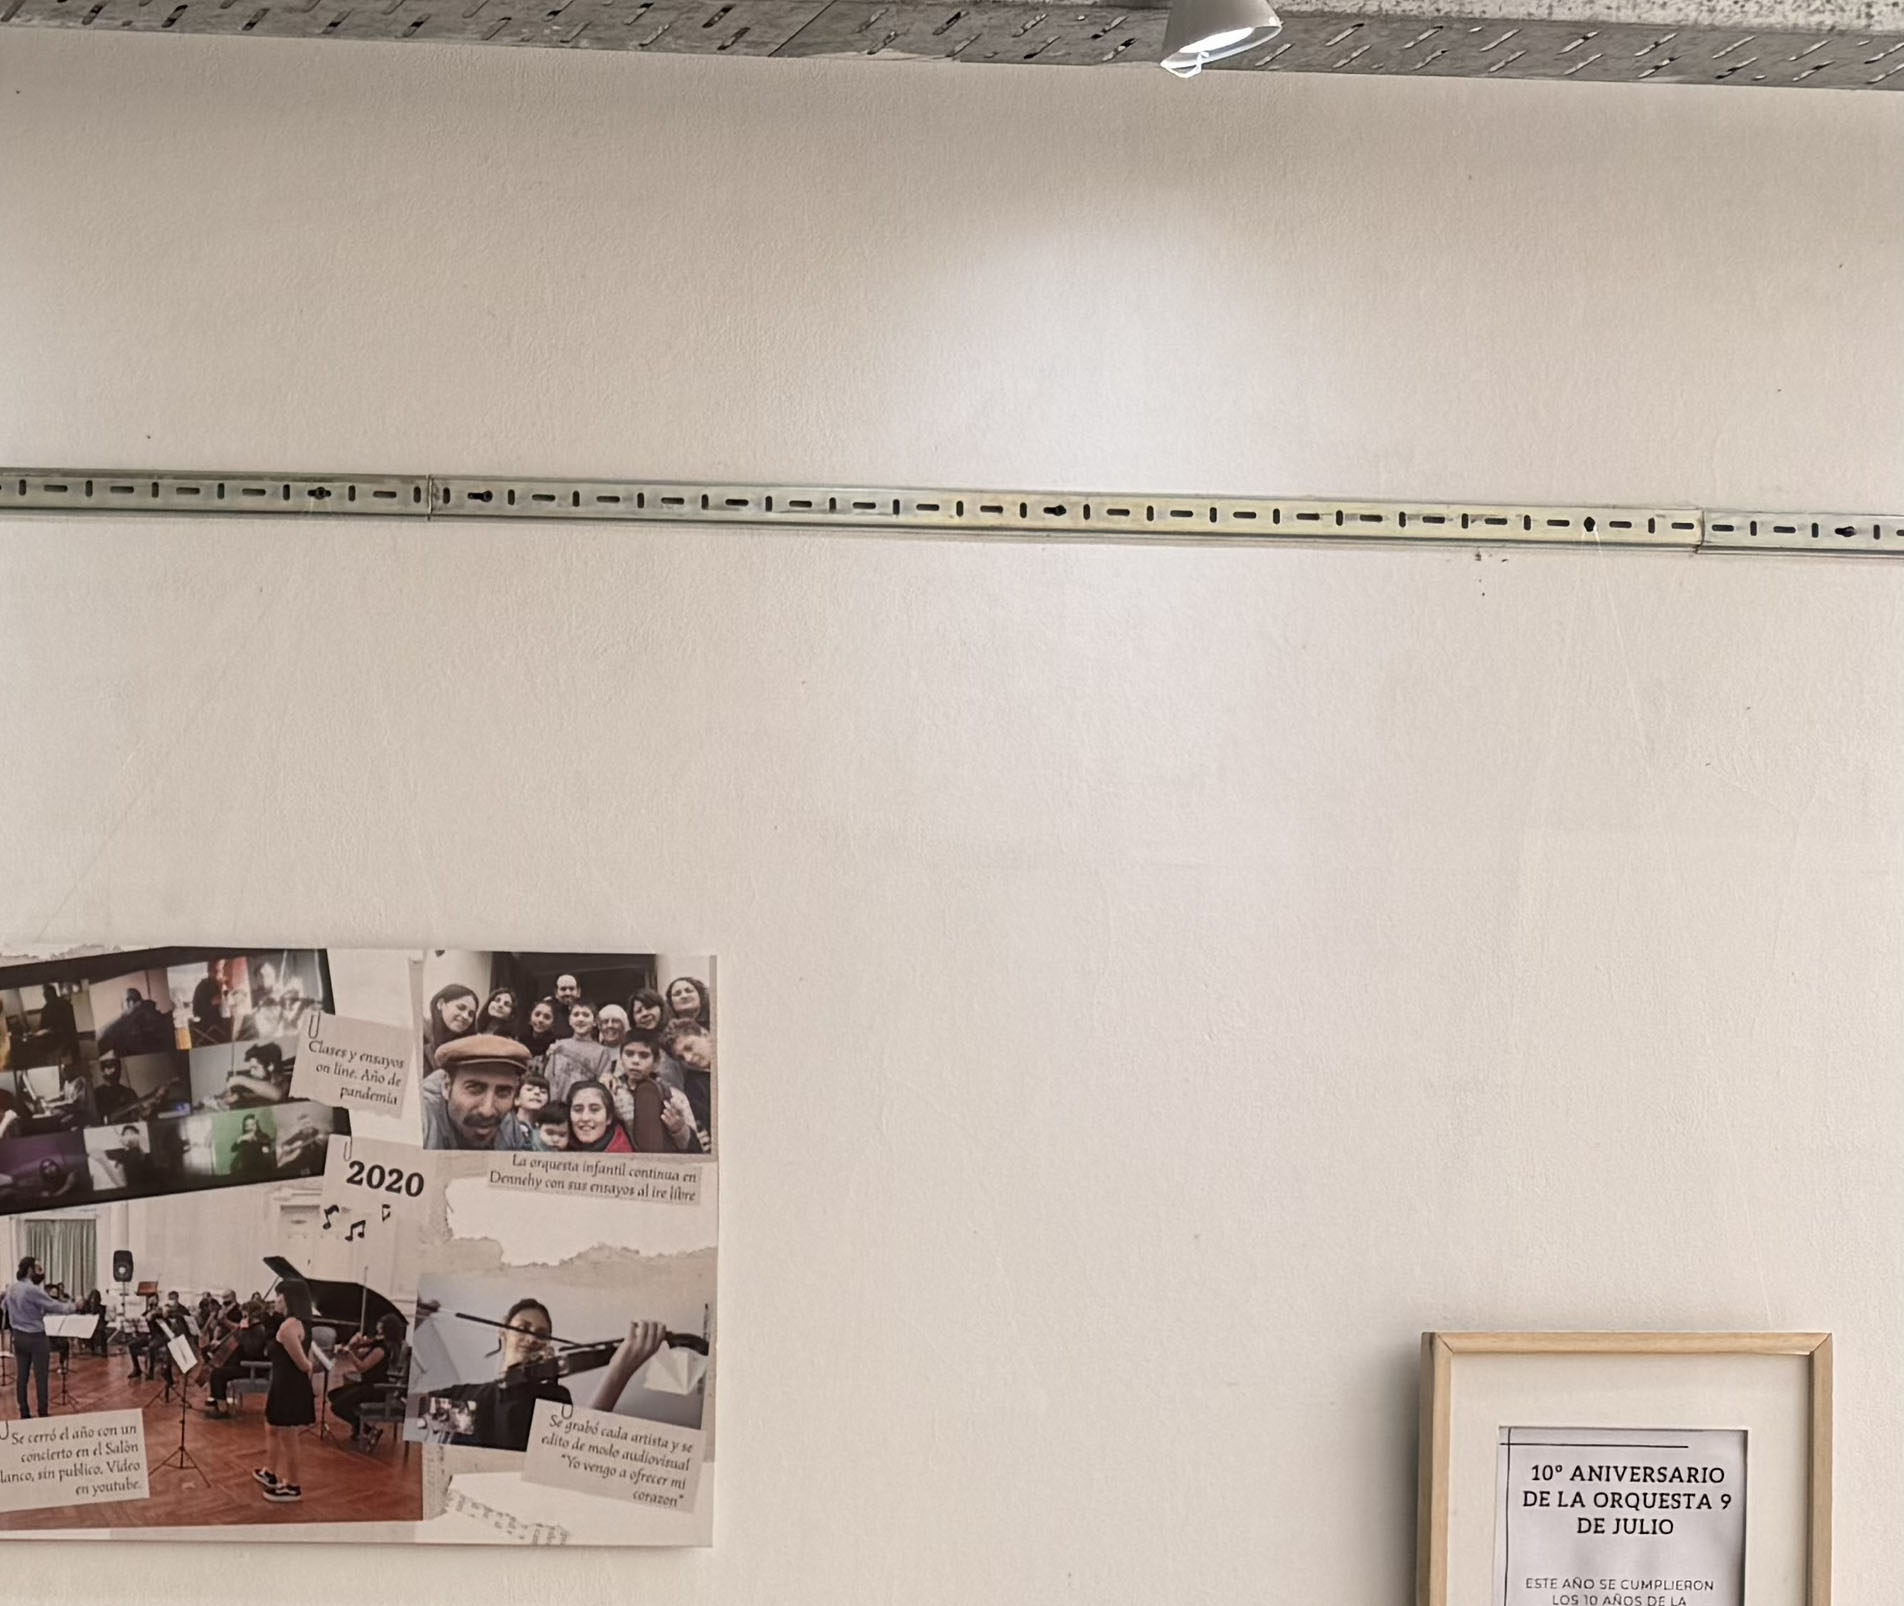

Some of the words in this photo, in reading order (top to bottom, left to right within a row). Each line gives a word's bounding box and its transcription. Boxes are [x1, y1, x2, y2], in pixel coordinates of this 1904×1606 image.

[308, 1039, 348, 1059] Clases
[347, 1050, 358, 1064] y
[359, 1052, 405, 1070] ensayos
[315, 1064, 331, 1074] on
[333, 1061, 358, 1079] line.
[360, 1068, 386, 1085] Año
[387, 1071, 402, 1087] de
[339, 1086, 398, 1106] pandemia
[345, 1160, 425, 1198] 2020
[1531, 1464, 1563, 1481] 10º
[1569, 1465, 1725, 1484] ANIVERSARIO
[1522, 1490, 1551, 1508] DE
[1557, 1490, 1586, 1508] LA
[1593, 1491, 1713, 1512] ORQUESTA
[1720, 1493, 1732, 1510] 9
[1576, 1517, 1606, 1535] DE
[1612, 1517, 1674, 1535] JULIO
